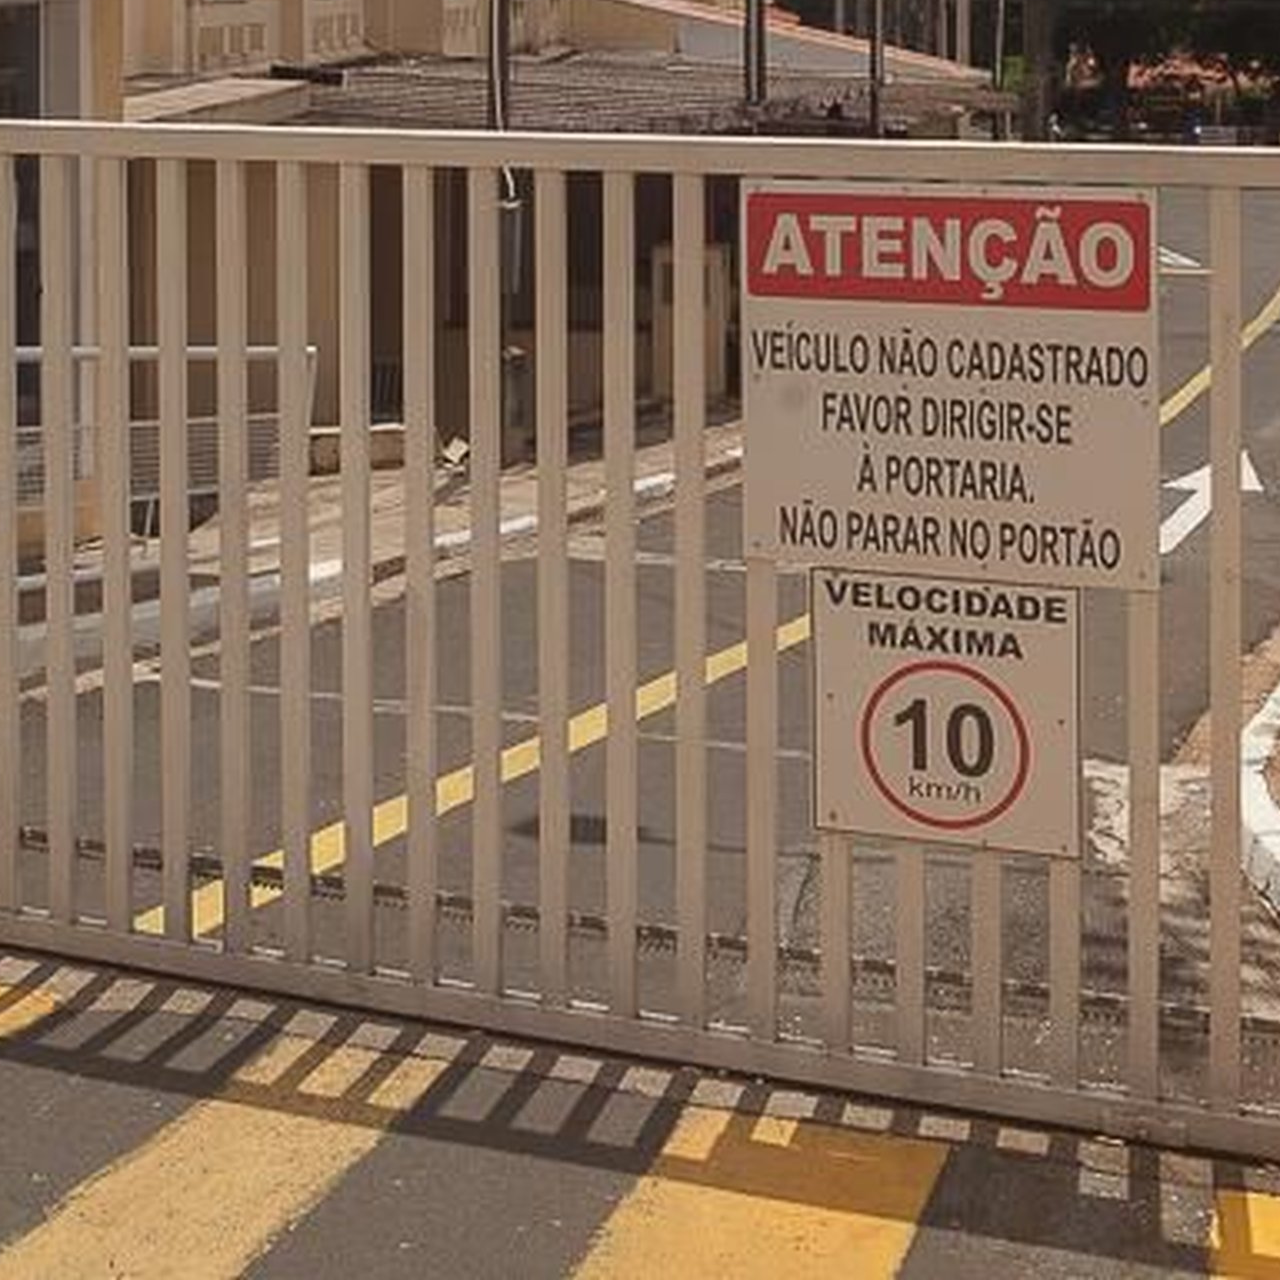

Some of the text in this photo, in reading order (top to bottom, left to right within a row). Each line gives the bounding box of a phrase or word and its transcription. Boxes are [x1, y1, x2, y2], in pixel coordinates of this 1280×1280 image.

[762, 205, 1135, 299] ATENÇÃO
[752, 321, 1148, 388] VEÍCULO NÃO CADASTRADO
[822, 392, 1072, 444] FAVOR DIRIGIR-SE
[857, 440, 1035, 504] À PORTARIA.
[780, 499, 1121, 570] NÃO PARAR NO PORTÃO
[824, 579, 1068, 624] VELOCIDADE
[869, 618, 1024, 659] MÁXIMA
[893, 698, 995, 778] 10
[909, 775, 983, 803] km/h
